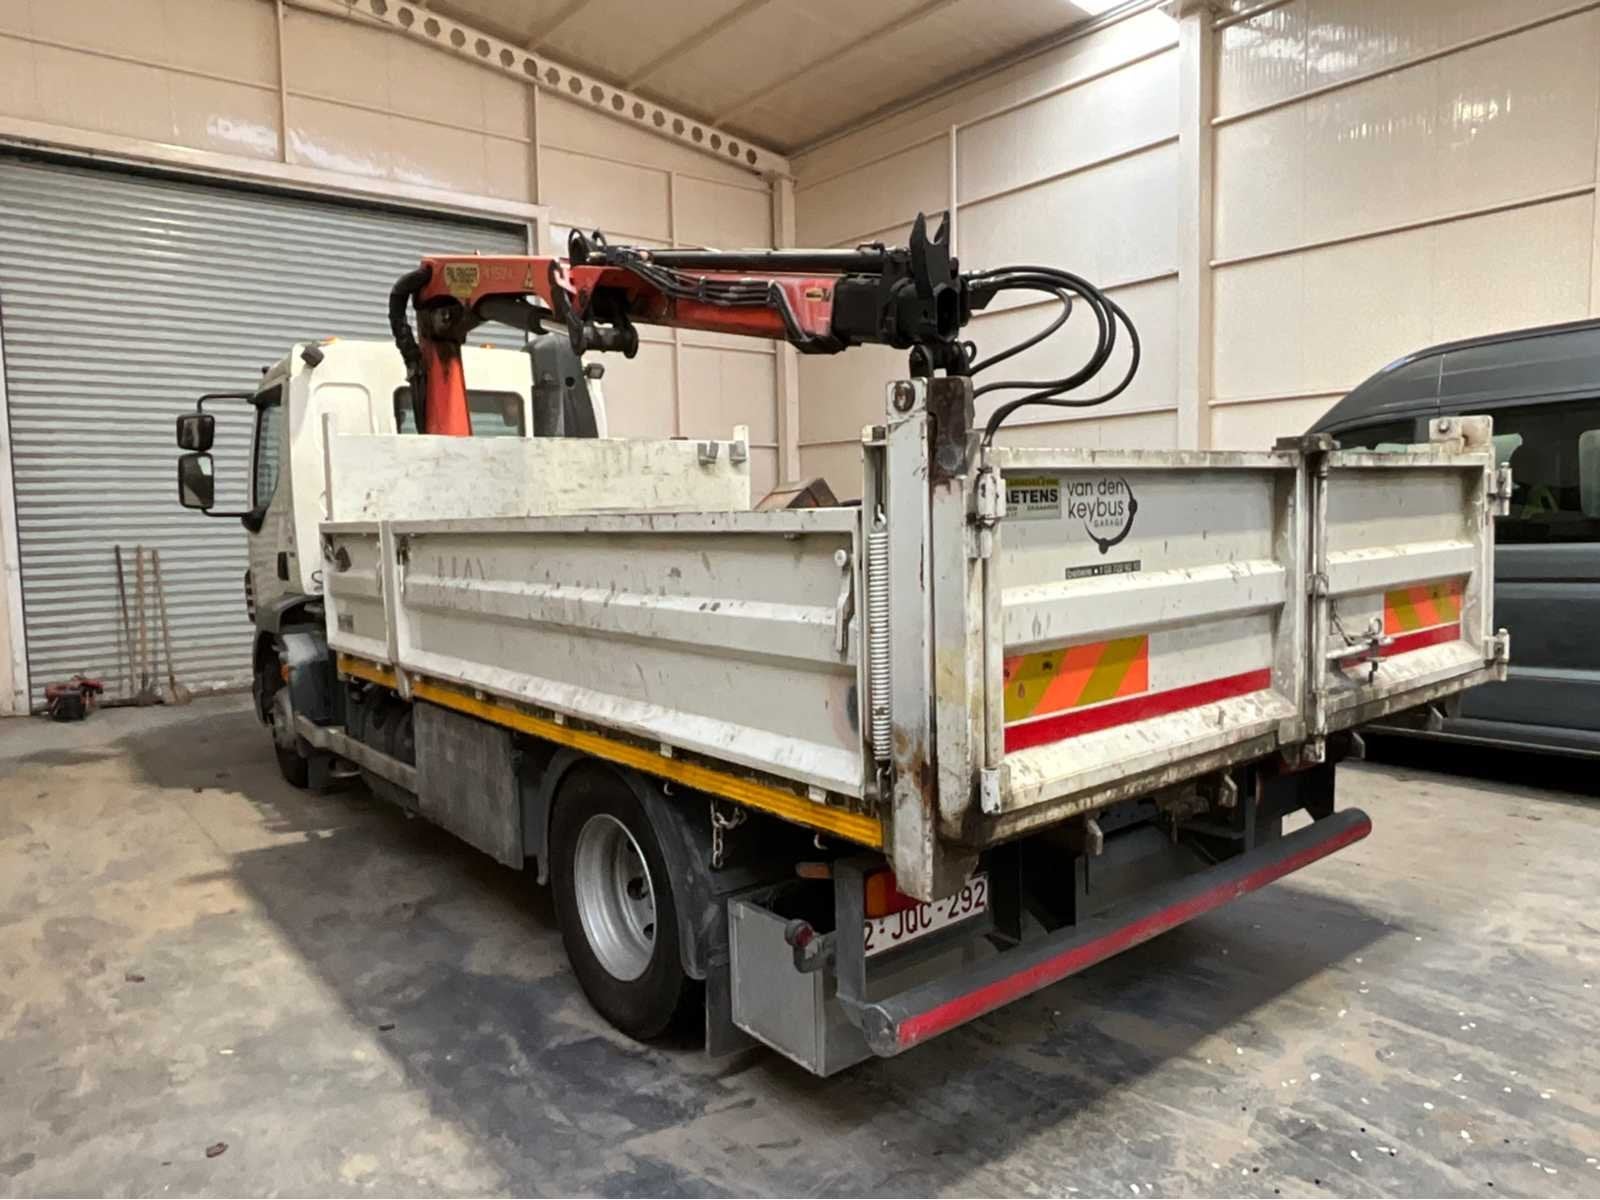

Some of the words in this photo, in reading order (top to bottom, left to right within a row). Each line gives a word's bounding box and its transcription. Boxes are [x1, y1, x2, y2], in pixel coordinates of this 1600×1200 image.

[1067, 480, 1093, 497] van
[1097, 478, 1124, 495] den
[1068, 498, 1124, 521] keybus
